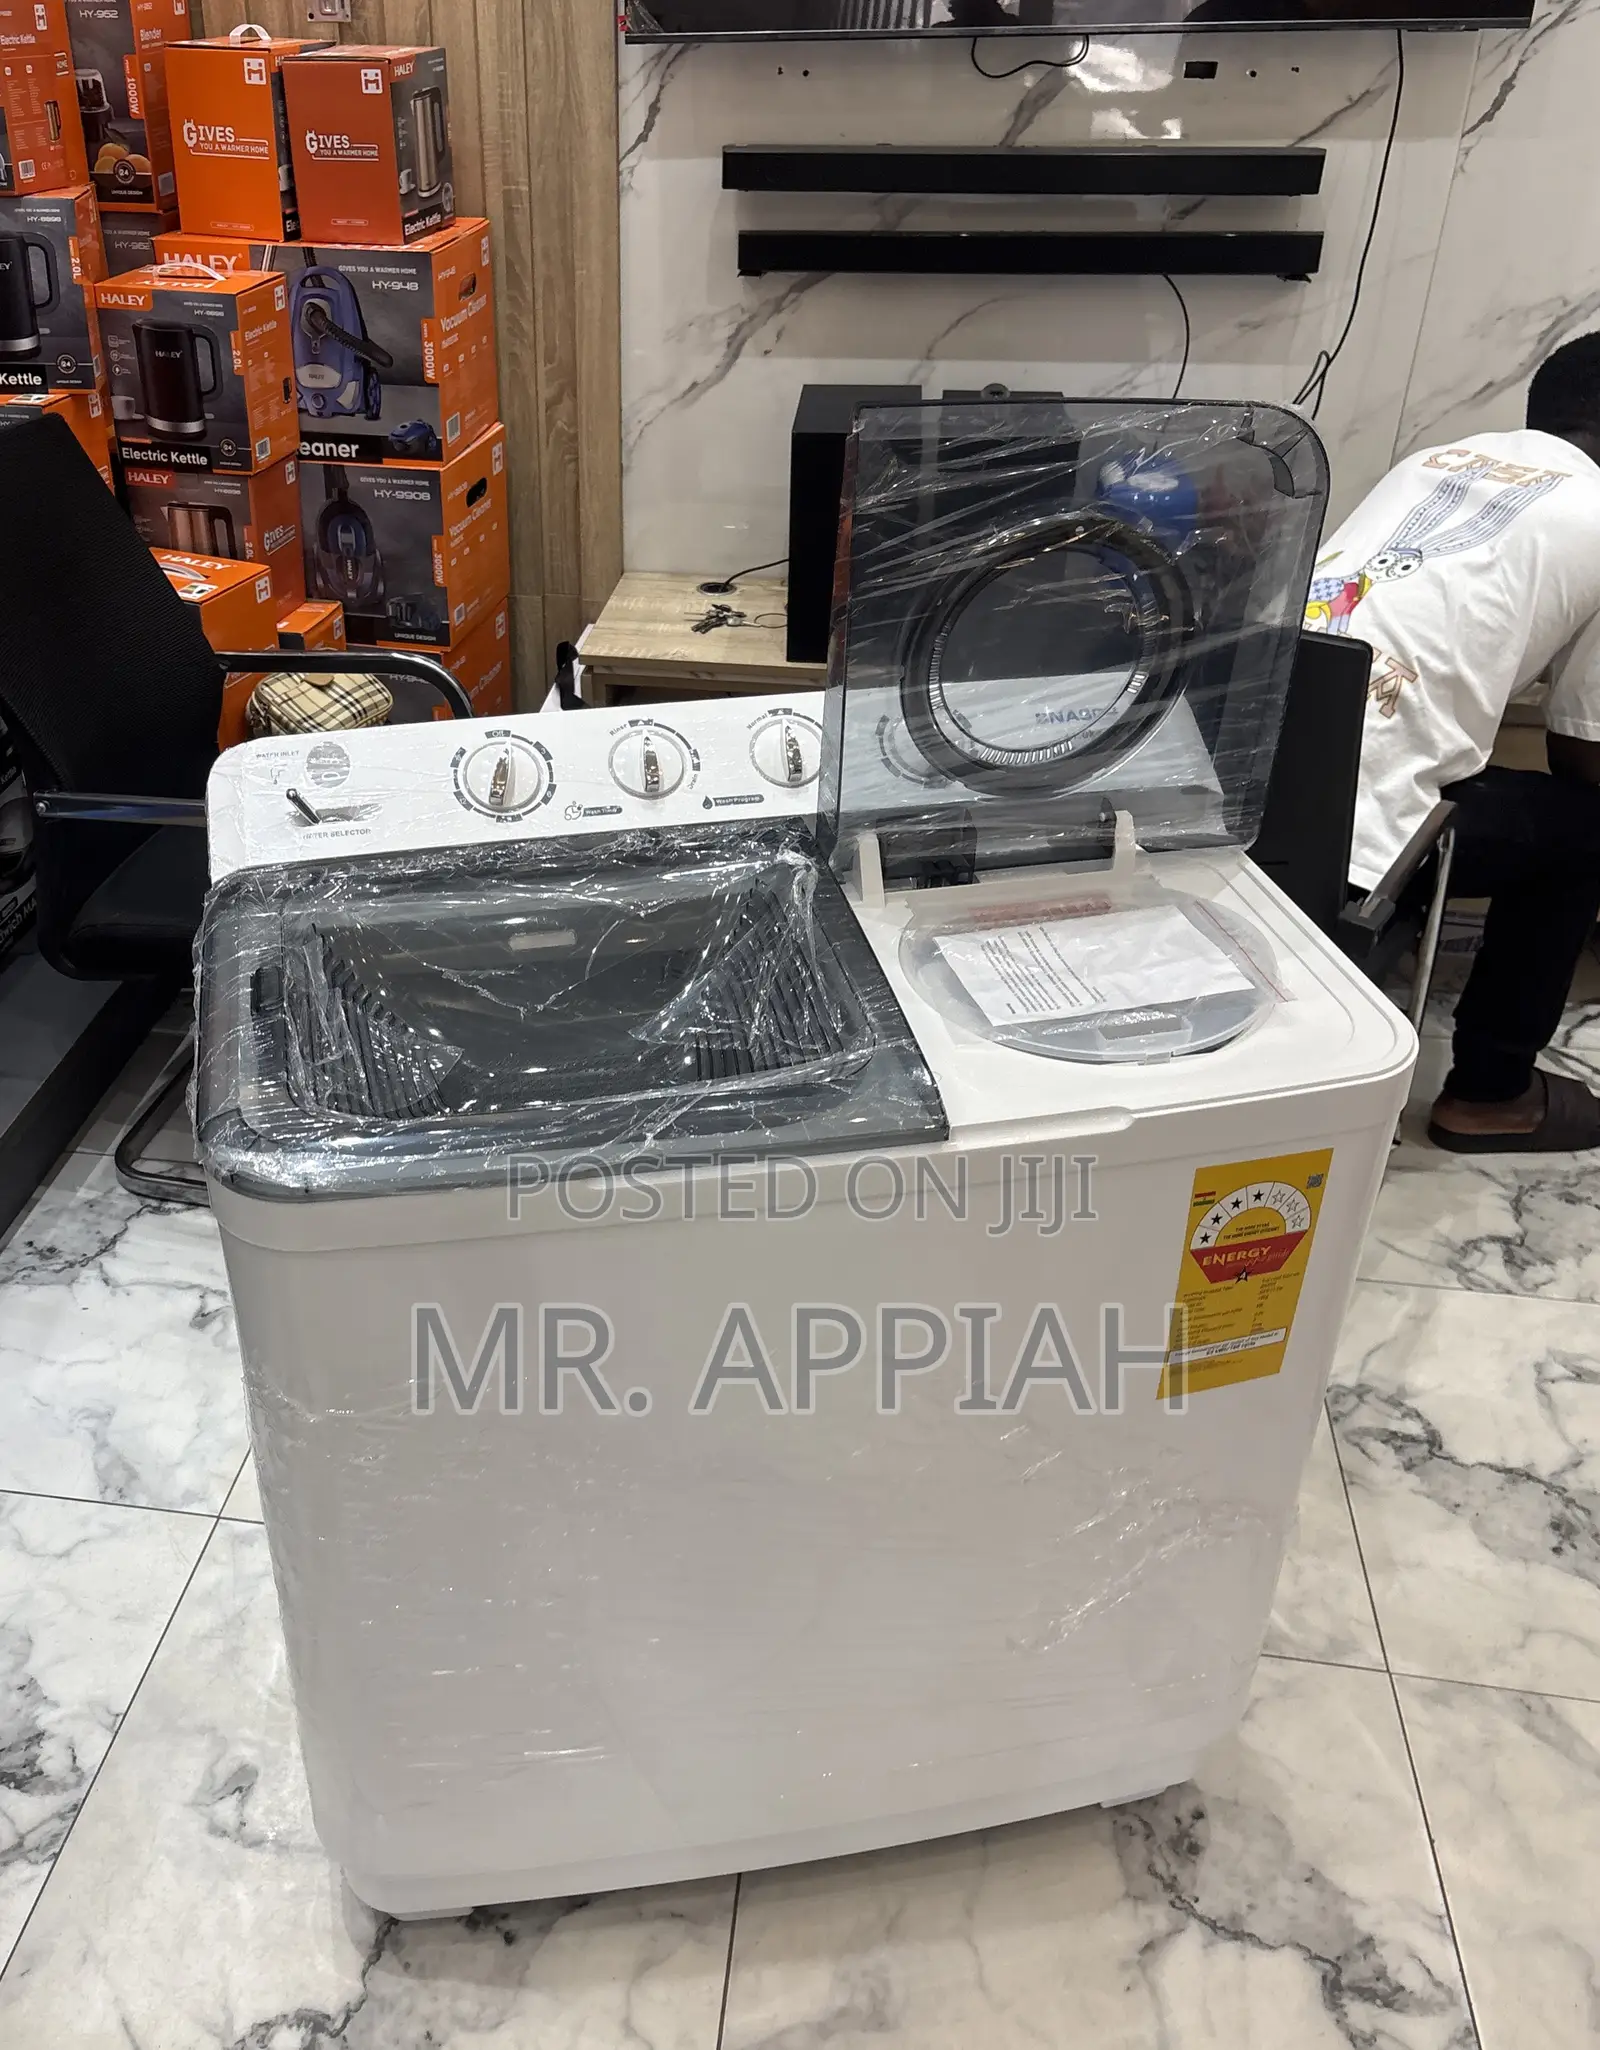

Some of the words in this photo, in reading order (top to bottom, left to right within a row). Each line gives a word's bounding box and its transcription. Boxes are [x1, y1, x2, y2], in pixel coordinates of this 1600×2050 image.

[79, 9, 119, 19] HY-952
[140, 28, 162, 42] Blender
[394, 60, 415, 77] HALEY
[127, 77, 140, 115] 1000W
[183, 118, 236, 148] GIVES
[199, 142, 213, 151] YOU
[221, 144, 249, 153] WARMER
[250, 145, 269, 155] HOME
[305, 130, 350, 154] GIVES
[338, 149, 362, 157] WARMER
[404, 219, 425, 236] Electric
[425, 212, 442, 227] Kettle
[70, 256, 83, 280] 2.0L
[338, 264, 356, 272] GIVES
[375, 266, 400, 274] WARMER
[371, 280, 419, 291] HY-948
[100, 292, 146, 307] HALEY
[440, 308, 468, 333] Vacuum
[244, 325, 263, 341] Electric
[232, 349, 242, 371] 2.0L
[424, 341, 436, 380] 3000W
[0, 372, 43, 386] Kettle
[121, 447, 169, 463] Electric
[170, 450, 208, 466] Kettle
[299, 440, 360, 459] eaner
[127, 471, 170, 485] HALEY
[373, 488, 432, 501] HY-9908
[160, 553, 233, 571] HALEY
[608, 722, 629, 737] Rinse
[745, 712, 769, 731] Normal
[491, 730, 505, 738] Off
[686, 772, 699, 791] Drain
[733, 796, 760, 805] Program
[330, 828, 372, 838] SELECTOR
[1202, 1245, 1271, 1267] ENERGY
